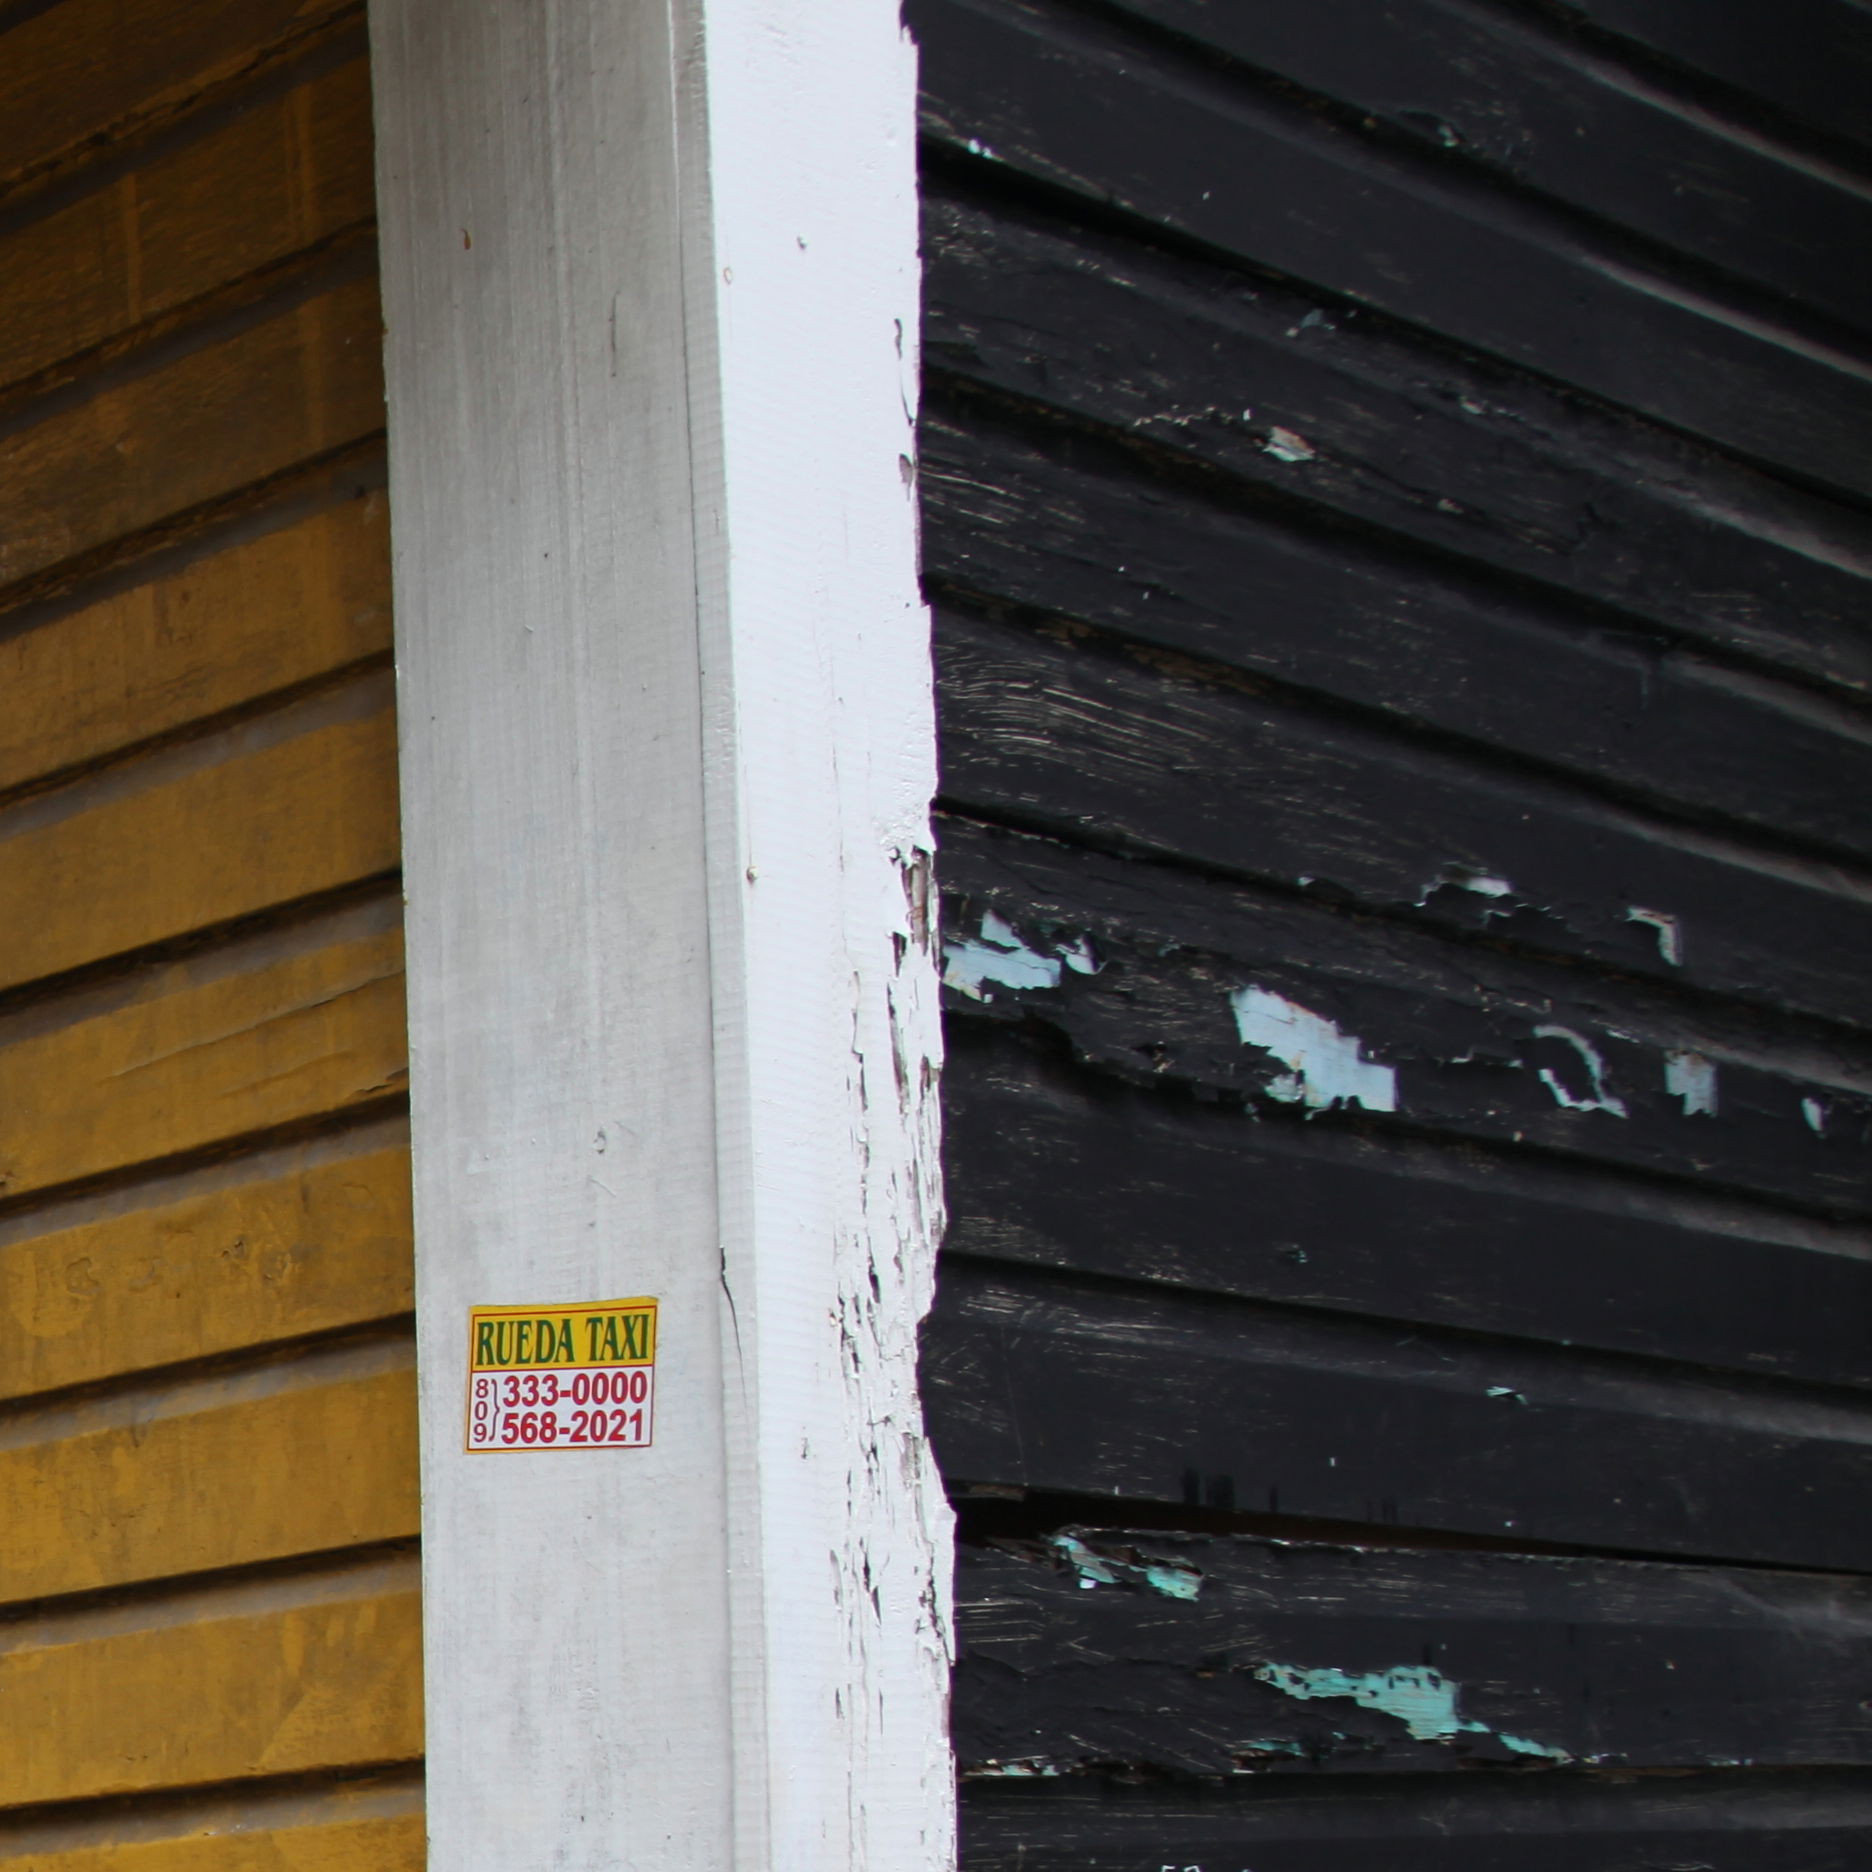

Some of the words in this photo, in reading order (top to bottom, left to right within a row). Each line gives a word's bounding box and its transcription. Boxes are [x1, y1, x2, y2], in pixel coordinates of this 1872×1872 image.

[475, 1319, 576, 1366] RUEDA
[586, 1313, 650, 1362] TAXI
[502, 1370, 648, 1408] 333-0000
[501, 1408, 643, 1444] 568-2021
